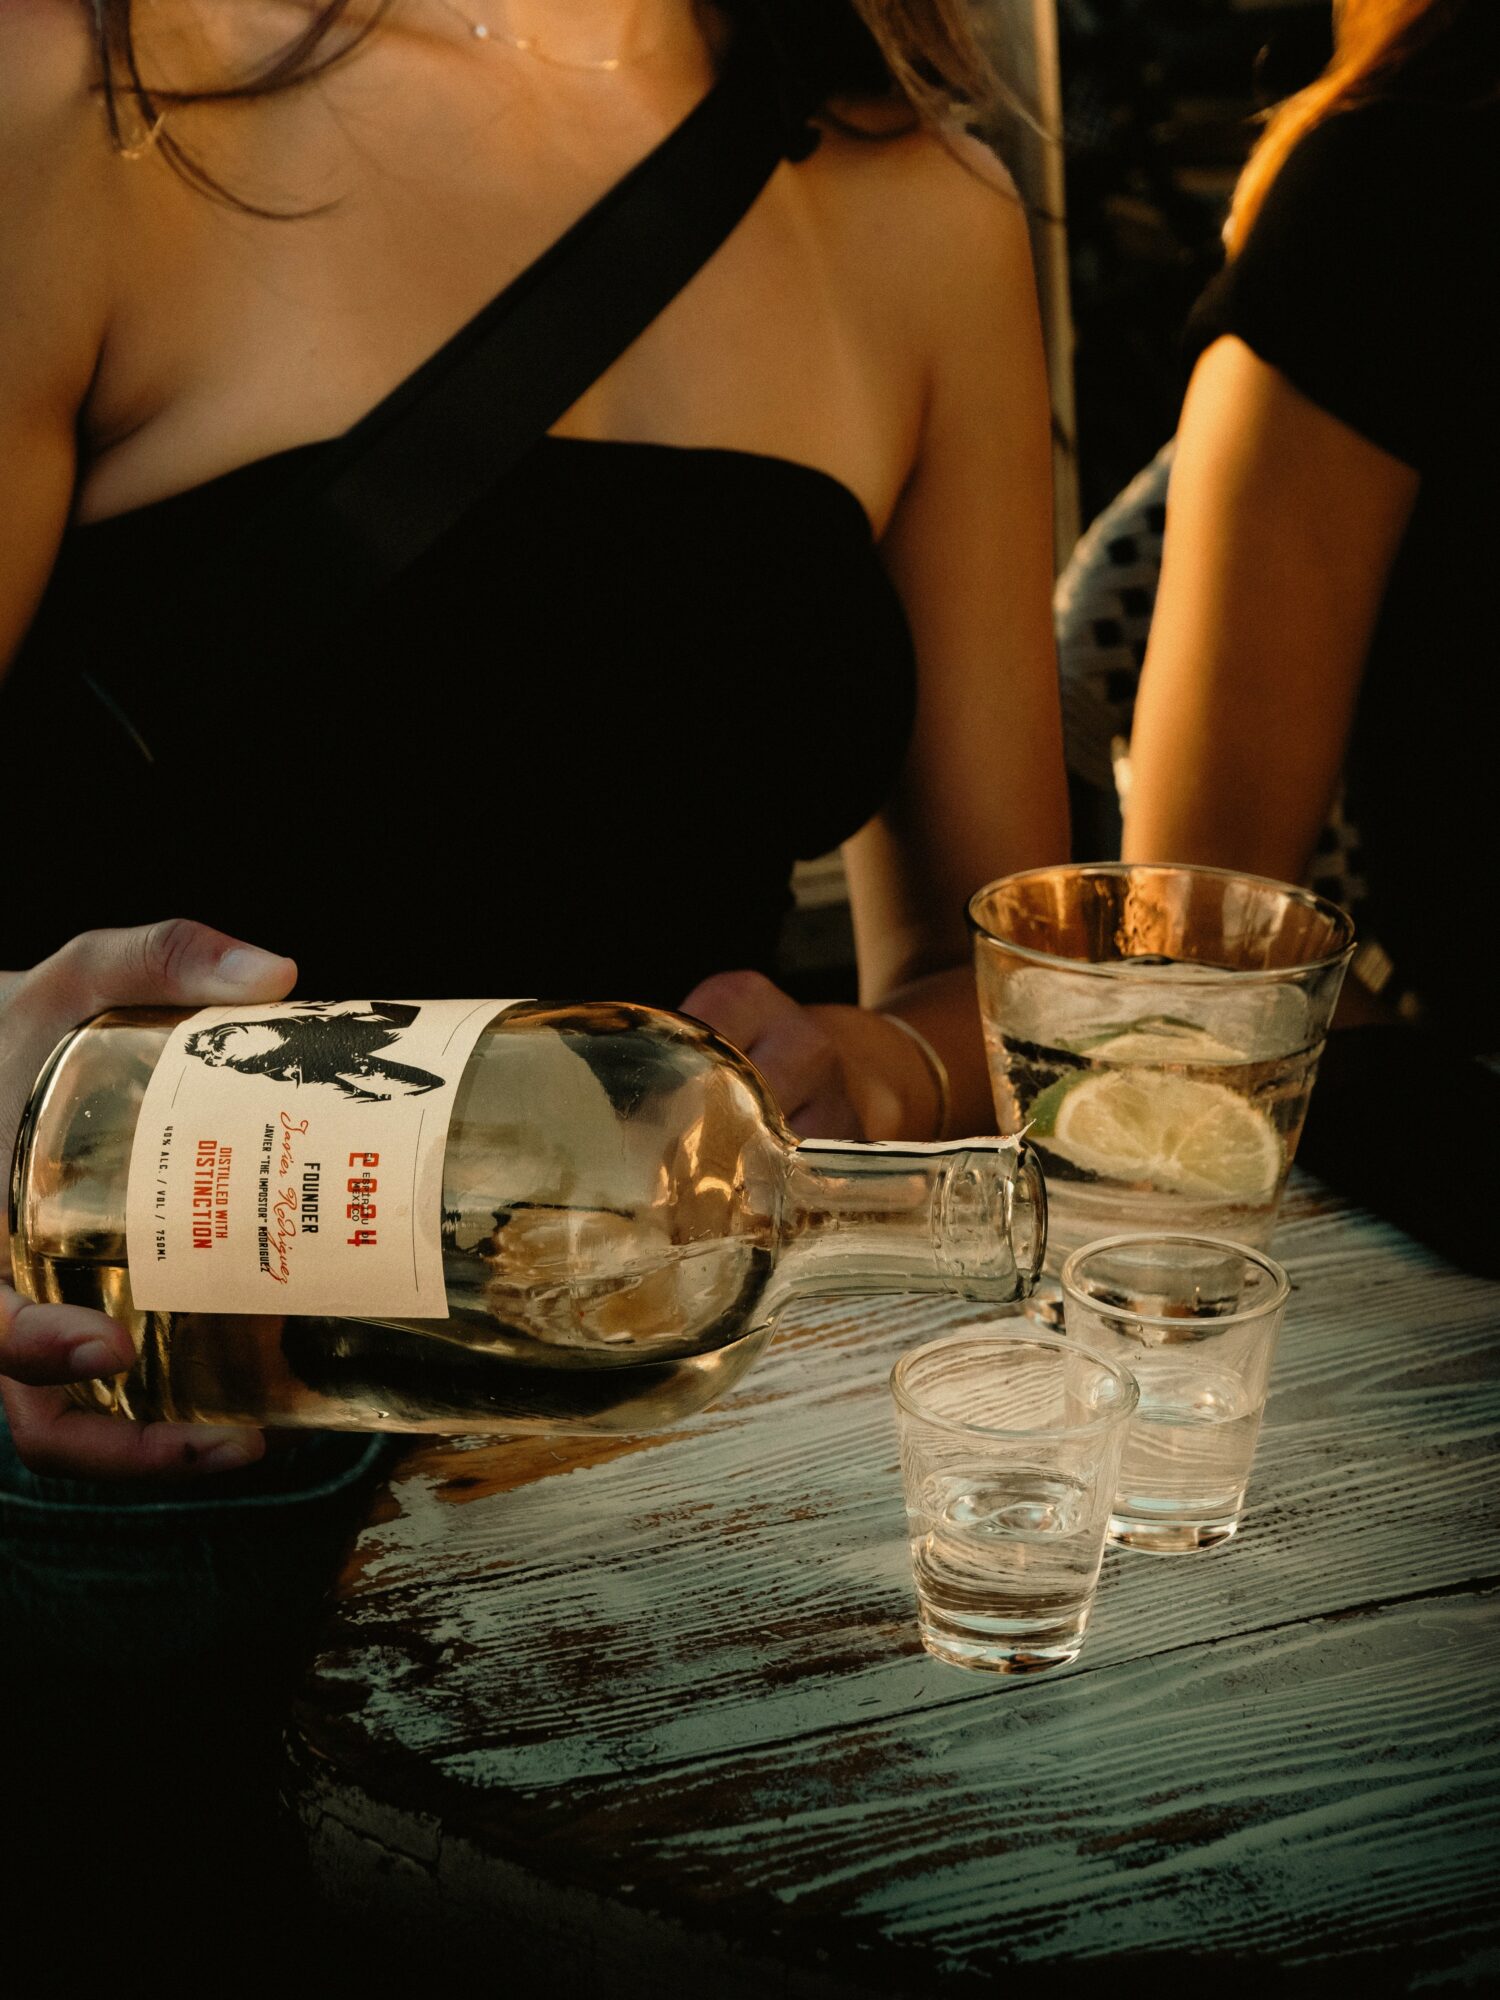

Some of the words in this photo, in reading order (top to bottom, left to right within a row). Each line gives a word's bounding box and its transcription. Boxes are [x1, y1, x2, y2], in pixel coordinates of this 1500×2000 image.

[162, 1125, 174, 1146] 40%
[262, 1123, 275, 1152] JAVIER
[279, 1111, 309, 1178] Javier
[158, 1151, 170, 1174] ALC.
[215, 1147, 233, 1205] DISTILLED
[155, 1190, 166, 1209] VOL
[192, 1140, 218, 1249] DISTINCTION
[302, 1162, 321, 1234] FOUNDER
[346, 1152, 380, 1247] 2024
[215, 1209, 228, 1238] WITH
[265, 1187, 298, 1285] Rodriguez
[361, 1232, 370, 1244] DE
[155, 1229, 167, 1262] 750ML
[257, 1226, 270, 1273] RODRIGUEZ
